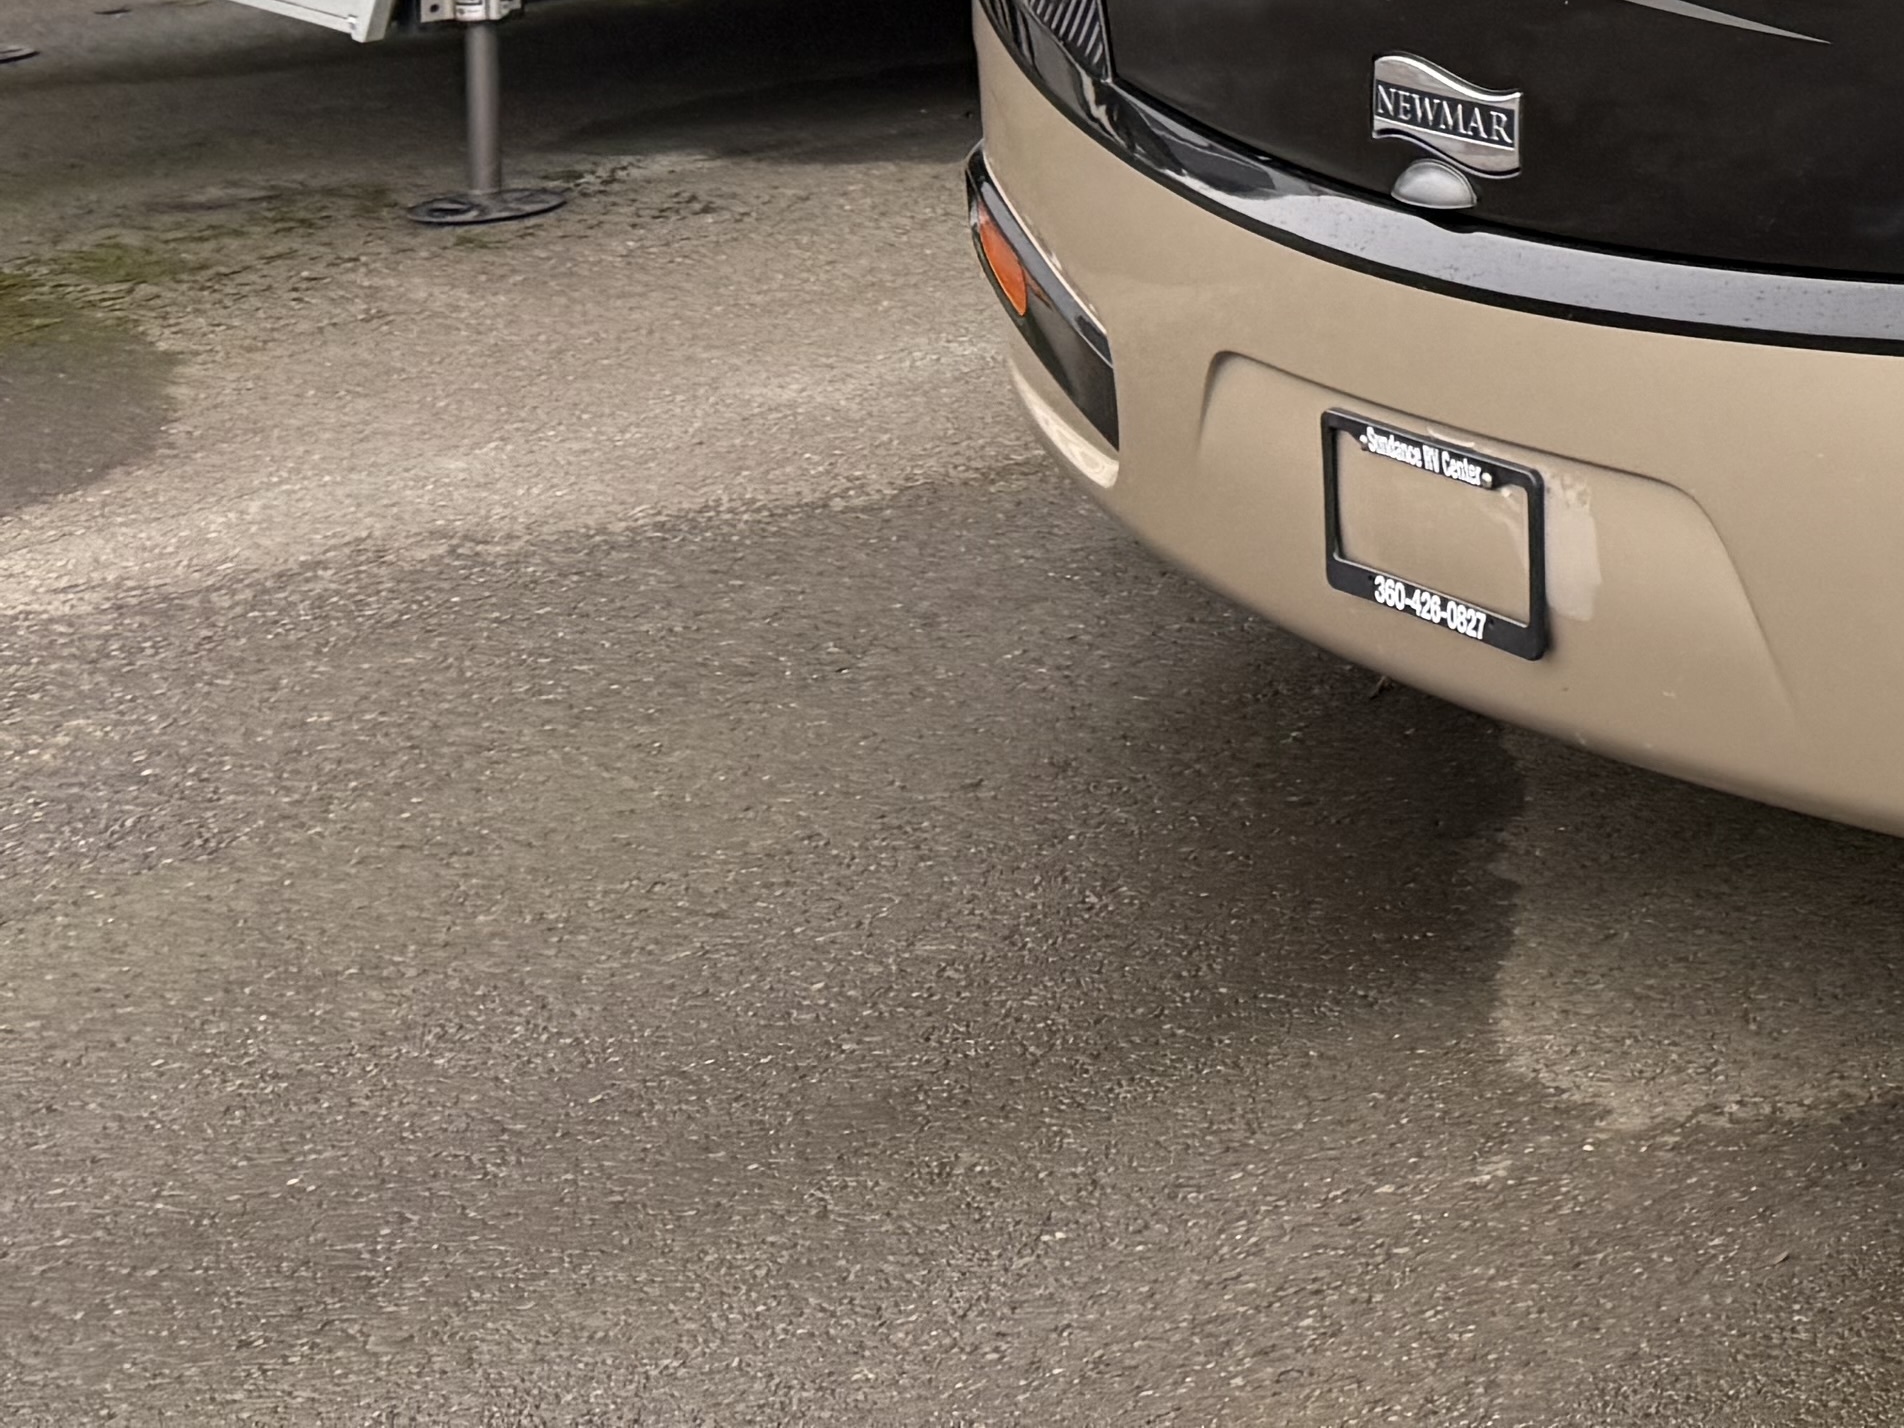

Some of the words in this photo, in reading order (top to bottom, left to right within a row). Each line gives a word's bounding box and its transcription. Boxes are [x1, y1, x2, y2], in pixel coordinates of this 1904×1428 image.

[1376, 84, 1513, 143] NEWMAR
[1366, 425, 1422, 468] Sundance
[1422, 444, 1440, 474] RV
[1441, 450, 1482, 486] Center
[1374, 575, 1487, 640] 360-426-0827
